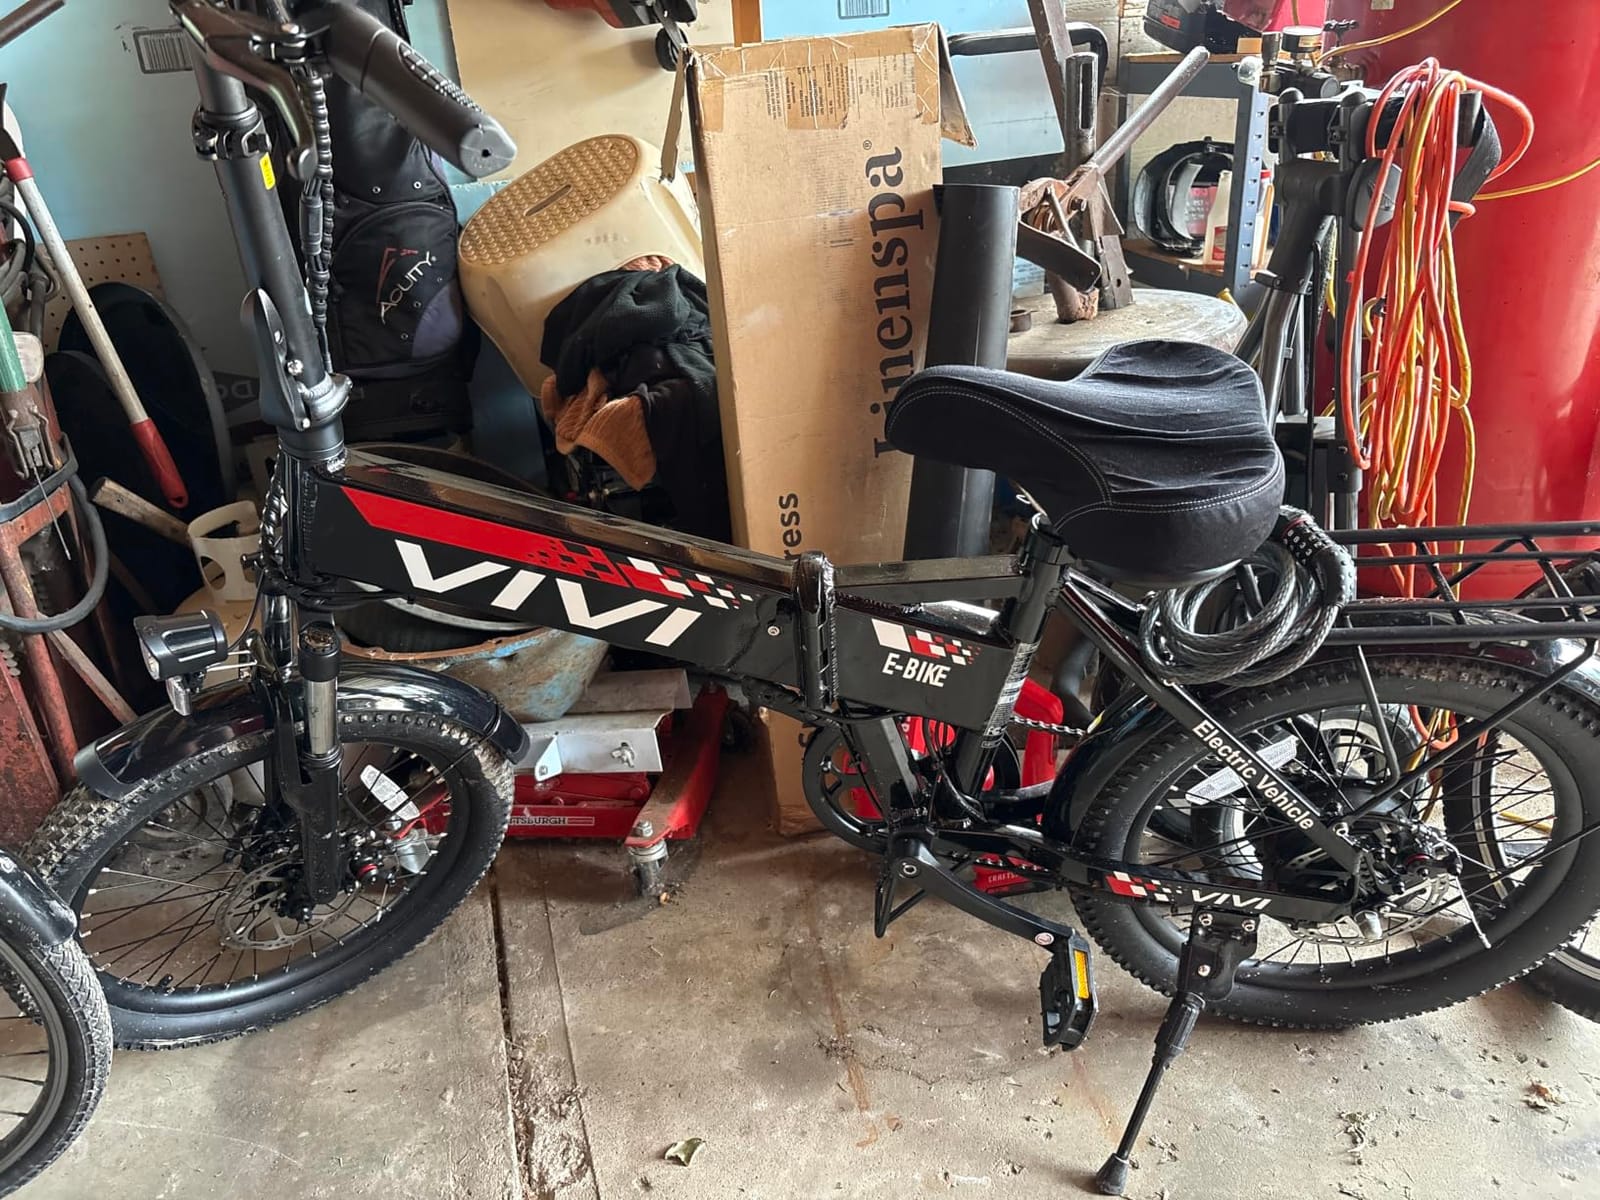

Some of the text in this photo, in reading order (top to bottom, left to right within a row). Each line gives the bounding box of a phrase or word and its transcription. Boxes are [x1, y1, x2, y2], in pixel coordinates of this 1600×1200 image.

[395, 539, 702, 647] VIVI
[882, 652, 951, 688] E-BIKE
[1192, 719, 1257, 780] Electric
[1256, 774, 1315, 830] Vehicle
[1192, 889, 1272, 909] VIVI
